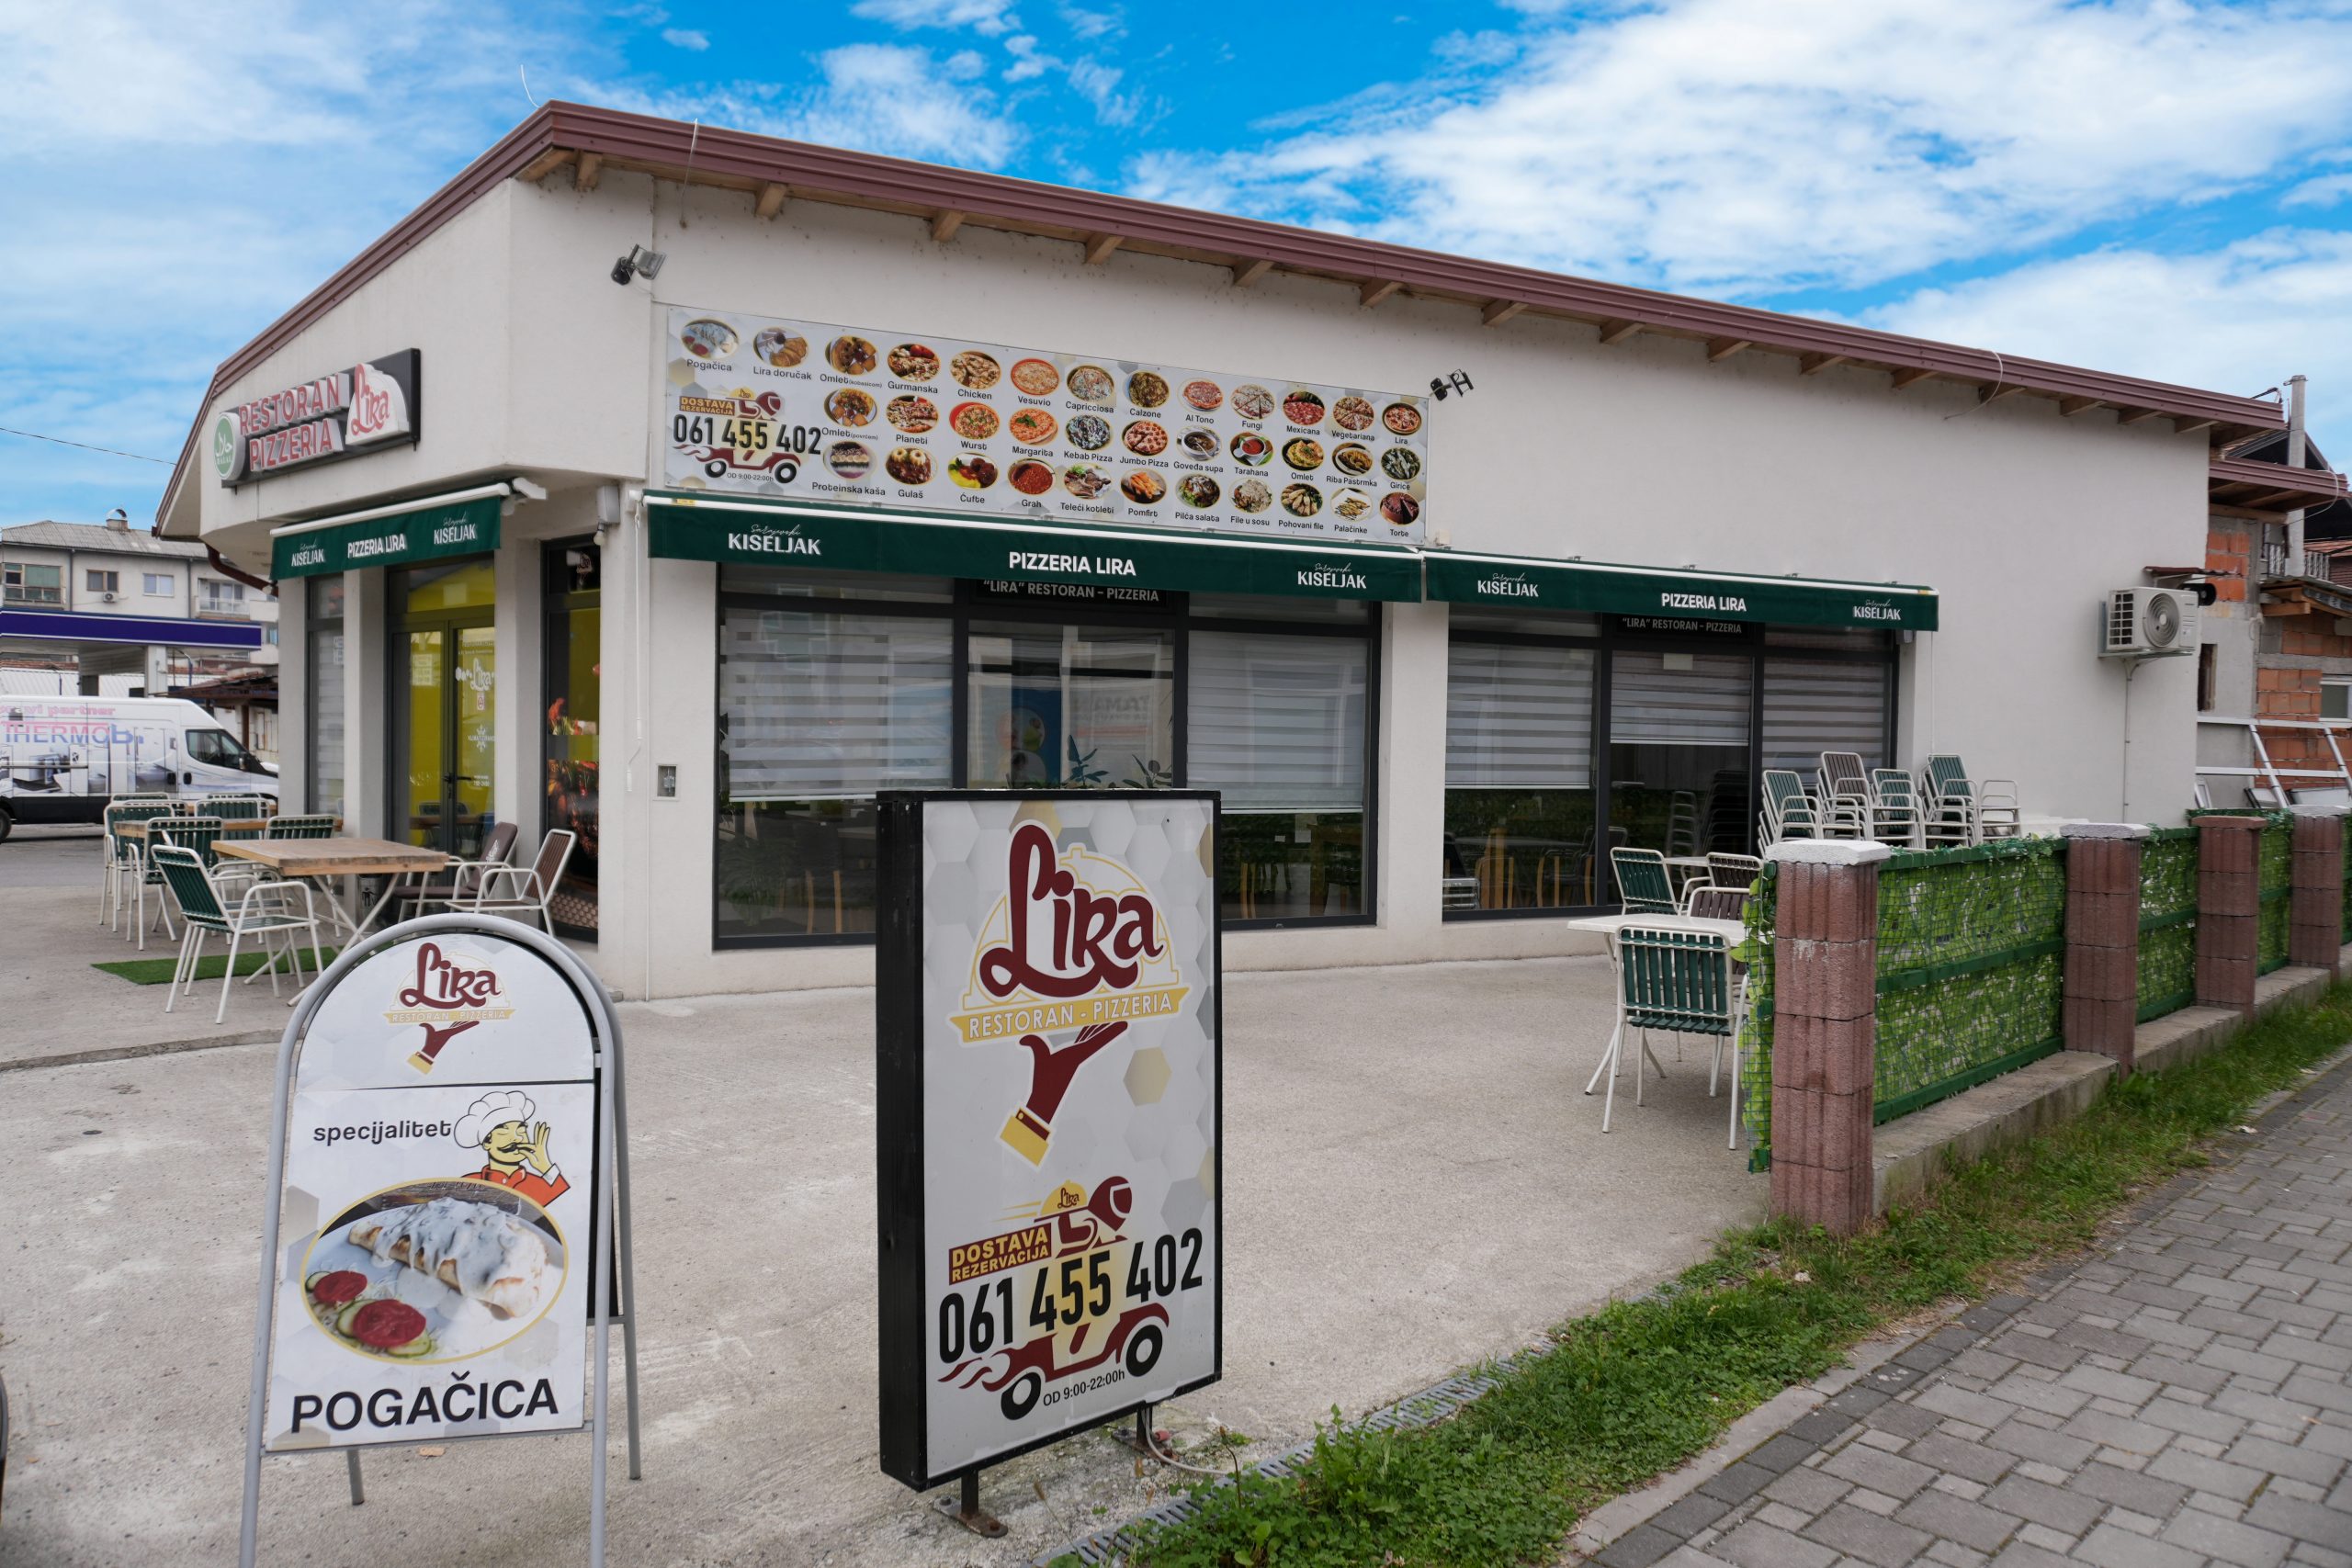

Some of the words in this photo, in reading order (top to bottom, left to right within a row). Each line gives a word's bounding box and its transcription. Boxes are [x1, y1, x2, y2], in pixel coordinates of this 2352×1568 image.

[686, 358, 732, 371] Pogačica
[753, 367, 771, 376] Lira
[774, 368, 812, 380] doručak
[888, 381, 938, 394] Gurmanska
[957, 389, 992, 400] Chicken
[239, 373, 341, 435] RESTORAN
[681, 397, 733, 409] DOSTAVA
[1017, 396, 1051, 407] Vesuvio
[1065, 400, 1114, 413] Capricciosa
[680, 405, 733, 415] REZERVACIJA
[1129, 408, 1161, 418] Calzone
[1185, 414, 1195, 423] Al
[1195, 415, 1215, 424] Tono
[1241, 420, 1263, 432] Fungi
[1286, 425, 1320, 435] Mexicana
[673, 413, 713, 446] 061
[721, 419, 768, 450] 455
[776, 424, 821, 455] 402
[896, 434, 928, 445] Planeti
[1331, 431, 1375, 442] Vegetariana
[249, 419, 335, 469] PIZZERIA
[960, 440, 988, 450] Wurst
[1395, 436, 1408, 445] Lira
[1012, 446, 1054, 457] Margarita
[1063, 451, 1090, 460] Kebab
[1091, 454, 1113, 463] Pizza
[1119, 457, 1147, 466] Jumbo
[1148, 458, 1169, 468] Pizza
[1204, 465, 1224, 473] supa
[1234, 467, 1269, 477] Tarahana
[1291, 472, 1314, 481] Omlet
[1326, 476, 1342, 484] Riba
[1343, 478, 1377, 487] Pastrmka
[811, 482, 863, 494] Proteinska
[865, 482, 886, 496] kaša
[1390, 481, 1410, 491] Girice
[898, 489, 923, 499] Gulaš
[1021, 499, 1042, 508] Grah
[1085, 504, 1114, 514] kotleti
[1128, 507, 1159, 517] Pomfirt
[1195, 513, 1220, 523] salata
[1230, 515, 1244, 524] File
[1278, 520, 1313, 529] Pohovani
[1313, 522, 1324, 530] file
[434, 523, 476, 545] KISELJAK
[1334, 525, 1368, 535] Palačinke
[1389, 528, 1409, 537] Torte
[347, 537, 384, 558] PIZZERIA
[385, 533, 406, 553] LIRA
[728, 533, 821, 556] KISELJAK
[291, 549, 324, 567] KISELJAK
[1009, 551, 1091, 573] PIZZERIA
[1096, 557, 1136, 576] LIRA
[1297, 570, 1367, 589] KISELJAK
[1028, 582, 1094, 598] RESTORAN
[1107, 588, 1159, 602] PIZZERIA
[1477, 580, 1539, 597] KISELJAK
[1661, 592, 1716, 610] PIZZERIA
[1719, 596, 1747, 612] LIRA
[1853, 605, 1901, 620] KISELJAK
[1653, 618, 1698, 631] RESTORAN
[1706, 622, 1742, 633] PIZZERIA
[392, 1011, 449, 1022] RESTORAN
[459, 1010, 505, 1021] PIZZERIA
[969, 1005, 1074, 1039] RESTORAN
[1093, 992, 1173, 1021] PIZZERIA
[313, 1119, 452, 1146] specijalitet
[952, 1227, 1048, 1267] DOSTAVA
[952, 1246, 1049, 1282] REZERVACIJA
[939, 1277, 1012, 1364] 061
[1030, 1249, 1112, 1332] 455
[1125, 1227, 1203, 1303] 402
[1043, 1391, 1061, 1407] OD
[1063, 1369, 1125, 1400] 9:00-22:00h
[291, 1370, 560, 1434] POGAČICA
